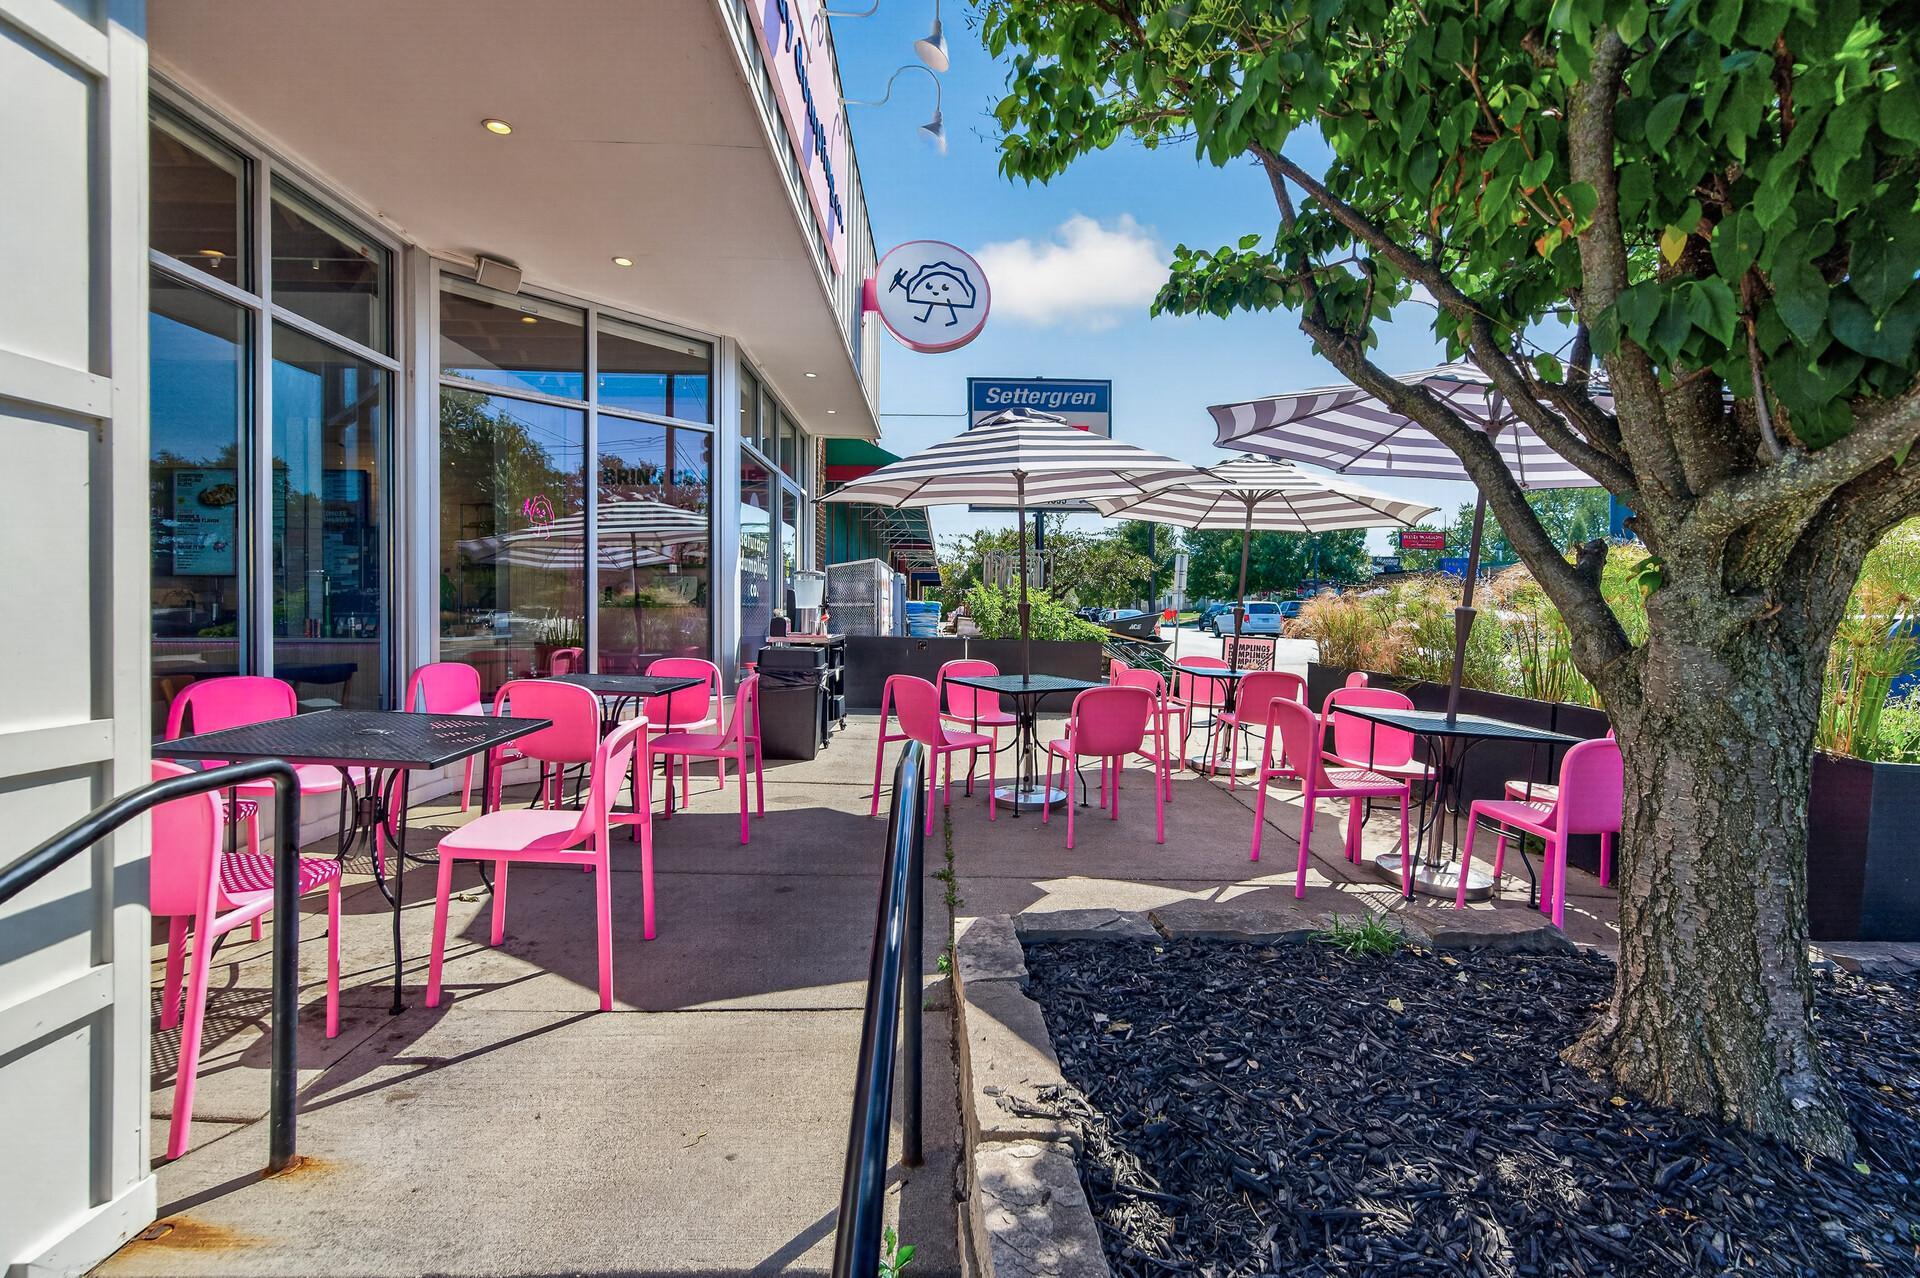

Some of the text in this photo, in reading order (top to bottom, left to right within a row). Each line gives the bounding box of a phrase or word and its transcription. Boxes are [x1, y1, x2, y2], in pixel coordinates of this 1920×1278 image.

[986, 387, 1097, 408] Settergren
[1228, 643, 1271, 653] DMPLINGS
[1228, 651, 1270, 660] DMPLINGS
